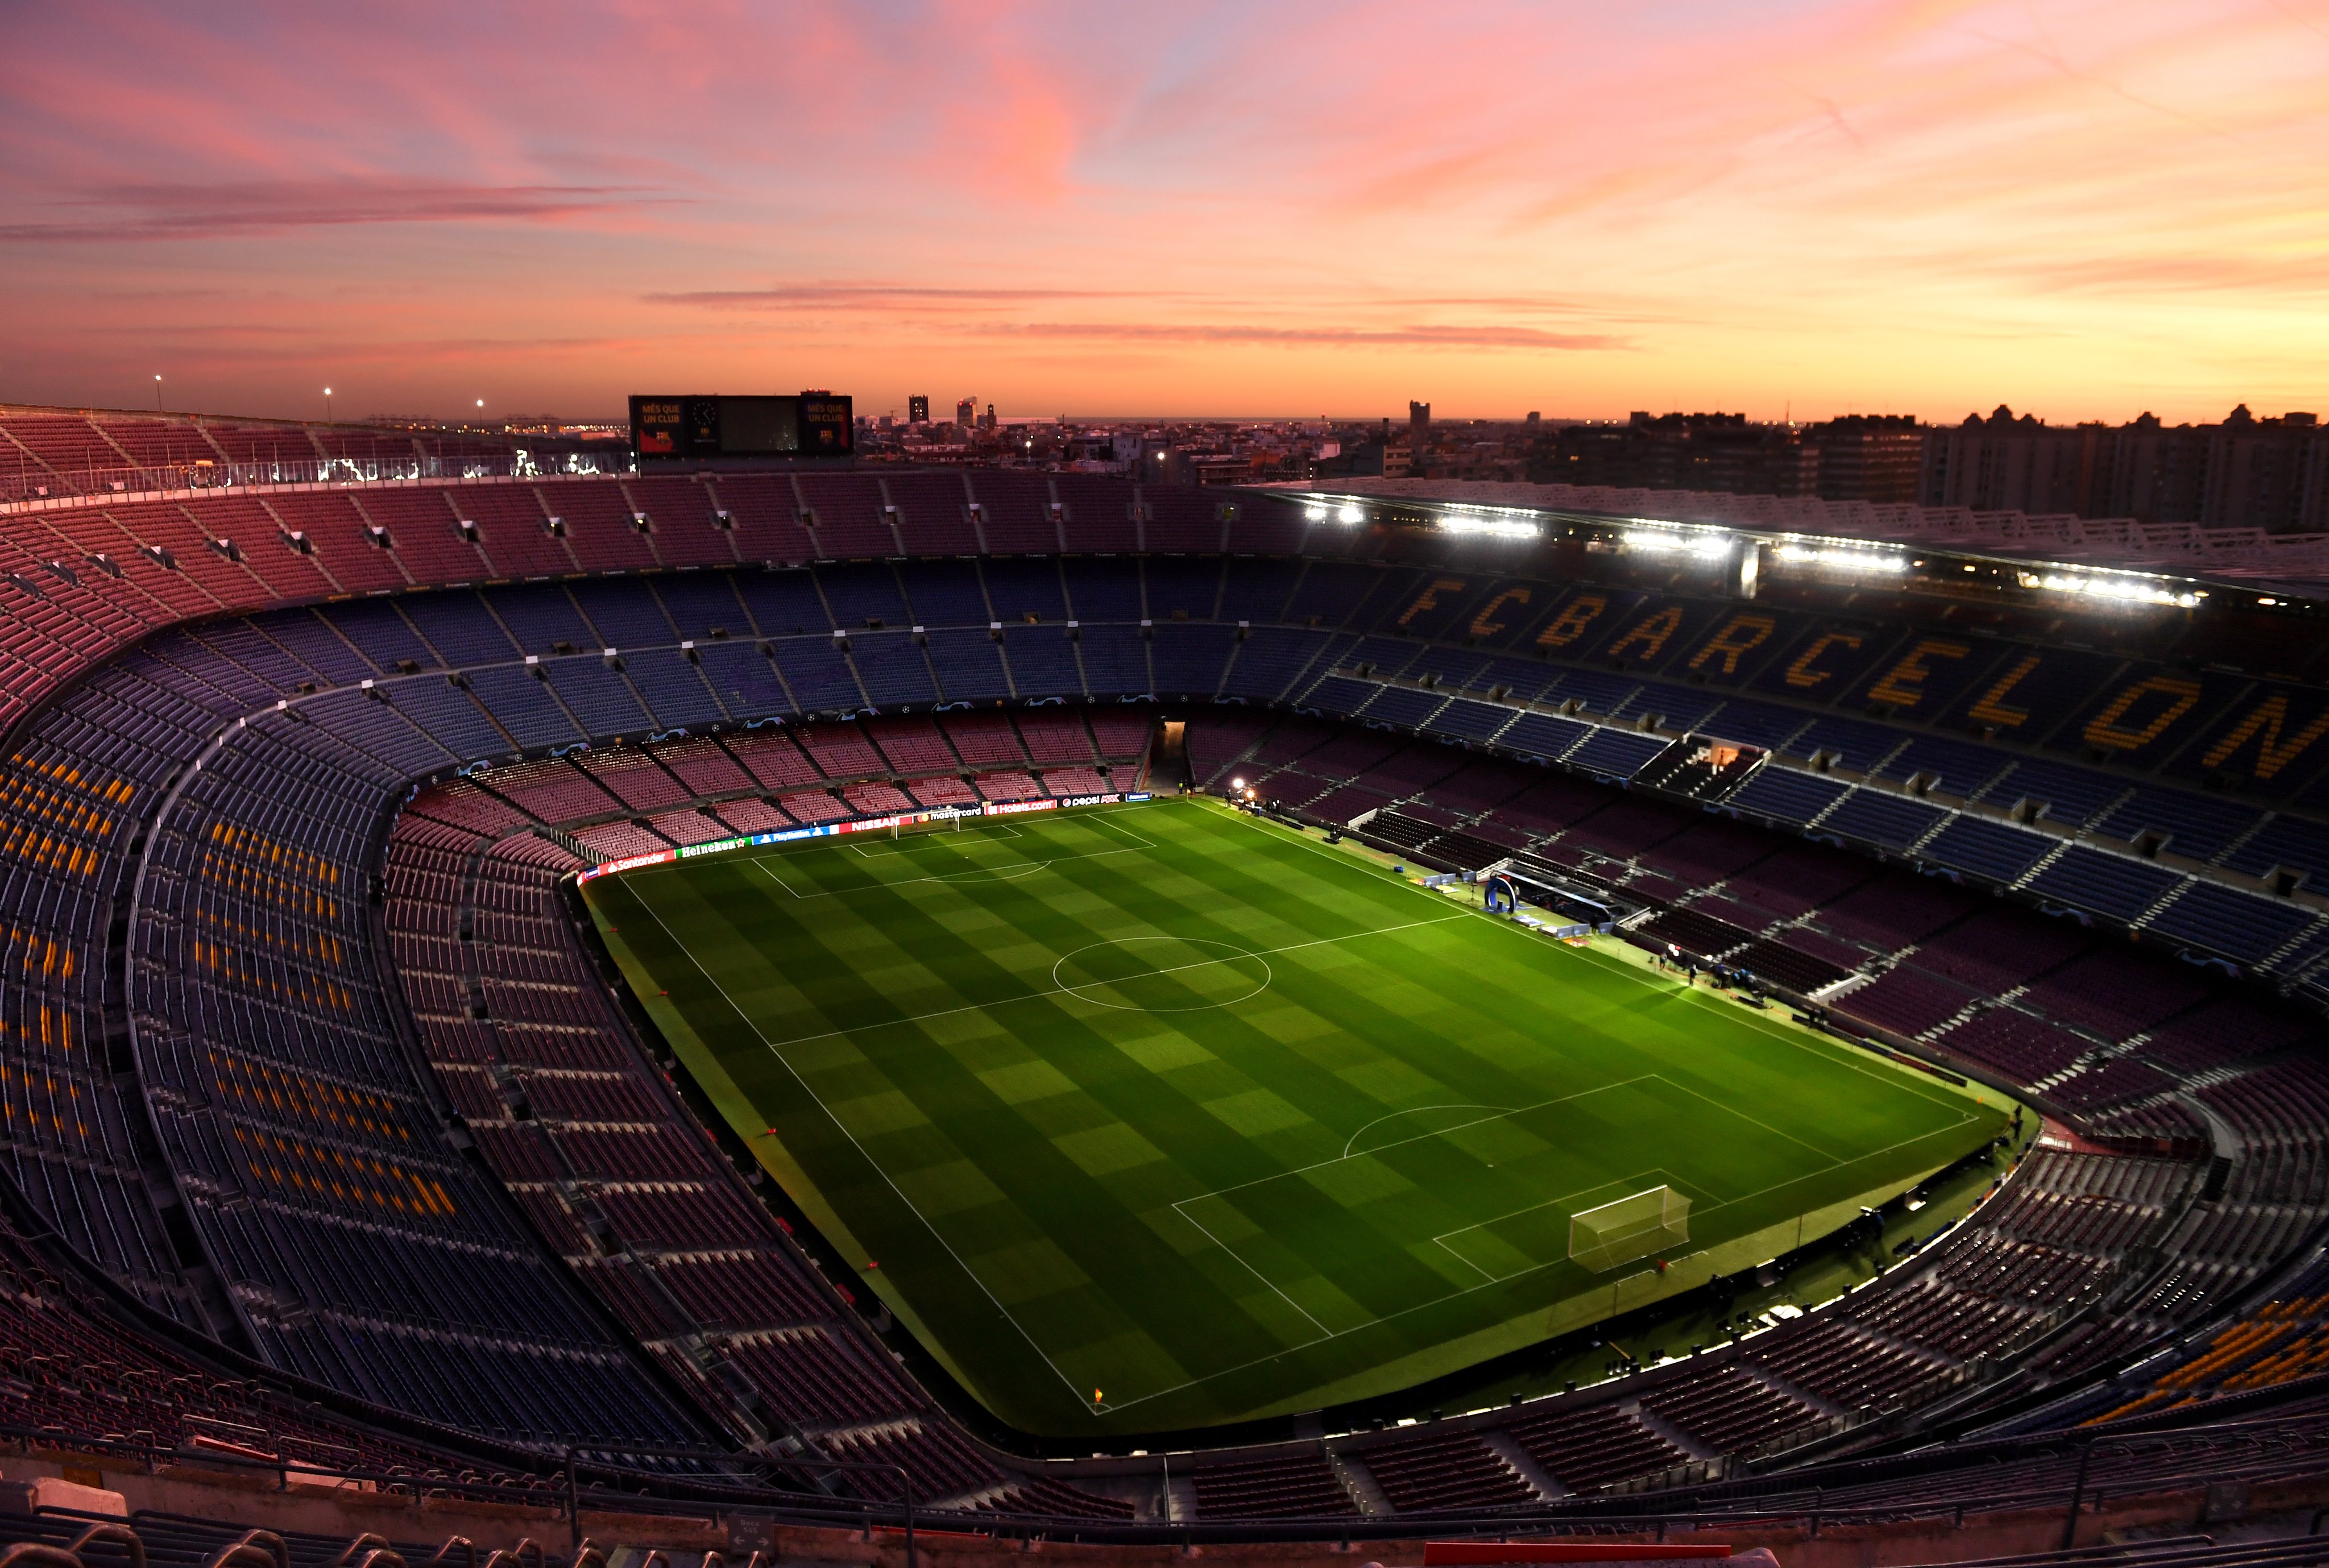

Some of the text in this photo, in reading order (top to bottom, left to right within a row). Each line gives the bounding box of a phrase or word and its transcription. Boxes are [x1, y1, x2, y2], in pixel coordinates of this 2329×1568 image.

[643, 403, 679, 414] MÉS QUE
[827, 404, 843, 413] QUE
[1072, 795, 1100, 807] pepsi
[1100, 794, 1120, 803] MAX
[930, 807, 981, 820] mastercard
[852, 817, 900, 831] NISSAN
[773, 831, 810, 841] PlayStation
[681, 842, 736, 858] Heineken
[618, 853, 665, 871] Santander
